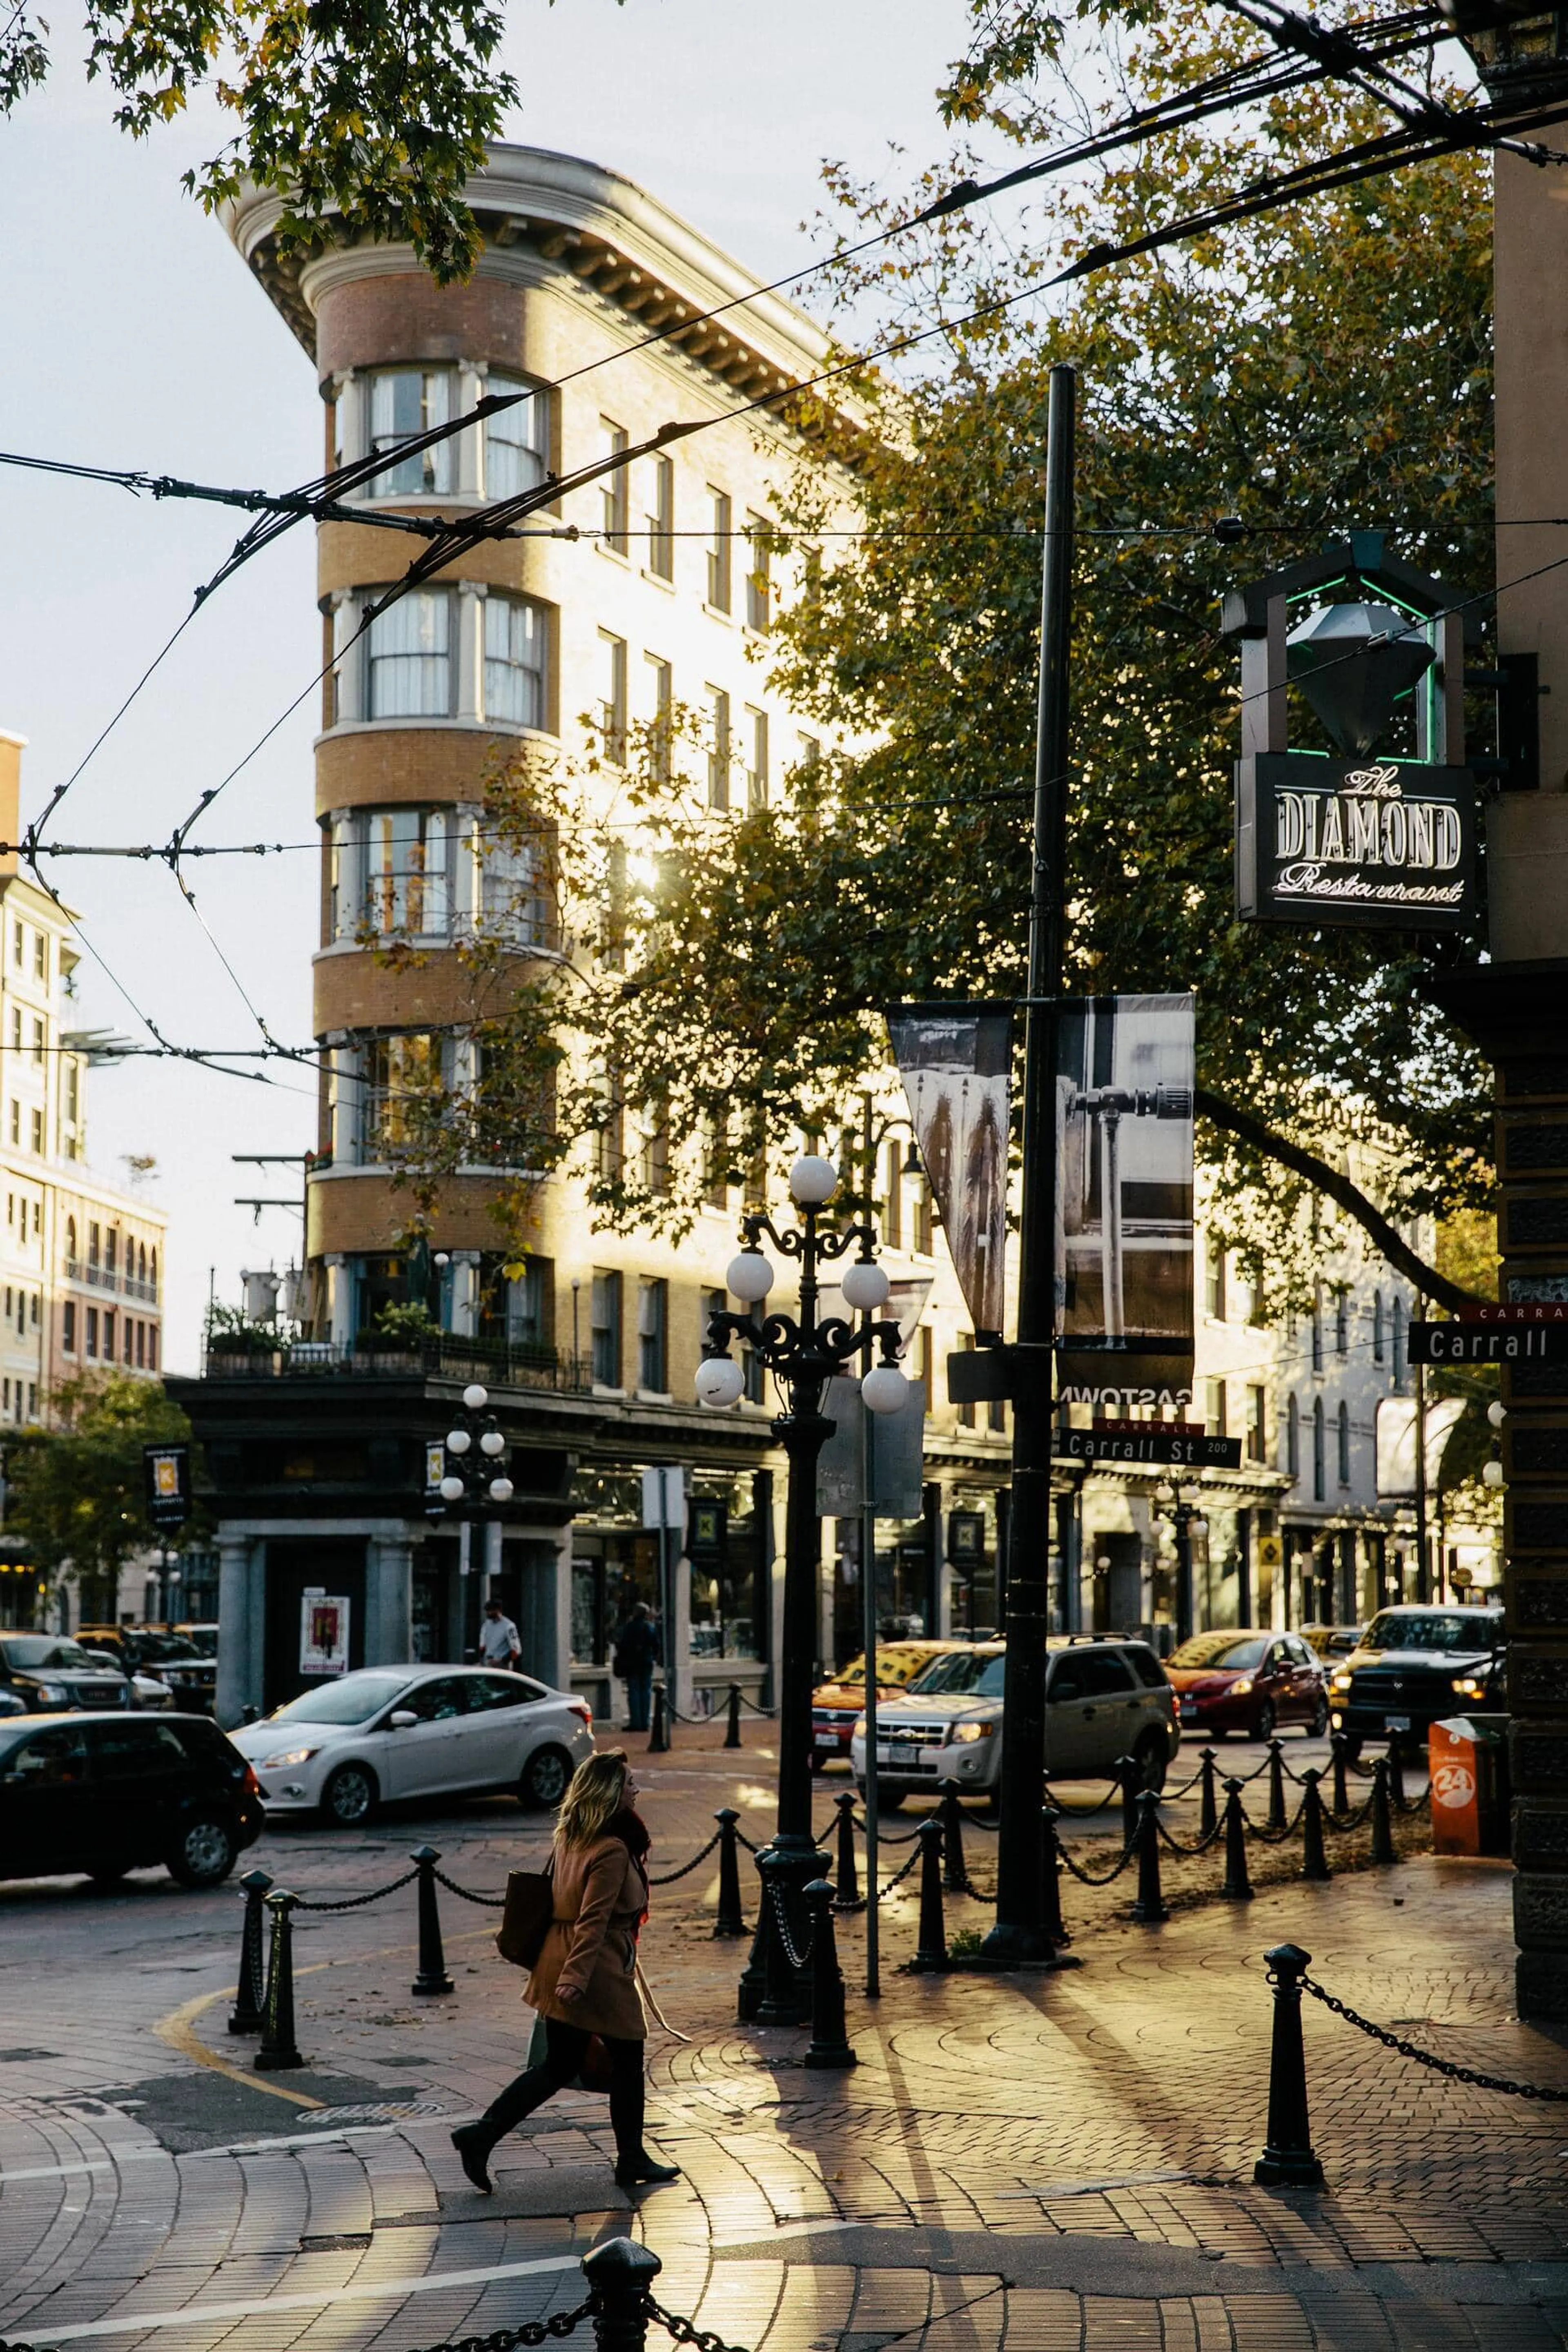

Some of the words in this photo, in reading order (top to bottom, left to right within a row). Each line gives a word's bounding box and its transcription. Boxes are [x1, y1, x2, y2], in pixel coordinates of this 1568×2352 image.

[1339, 766, 1402, 798] The
[1274, 792, 1461, 870] DIAMOND
[1271, 862, 1465, 903] Restaurant
[1430, 1330, 1546, 1358] Carrall
[1106, 1421, 1192, 1434] CARRALL
[1069, 1435, 1154, 1459] Carrall
[1170, 1441, 1194, 1461] St
[1207, 1442, 1228, 1453] 200
[1438, 1769, 1468, 1791] 24
